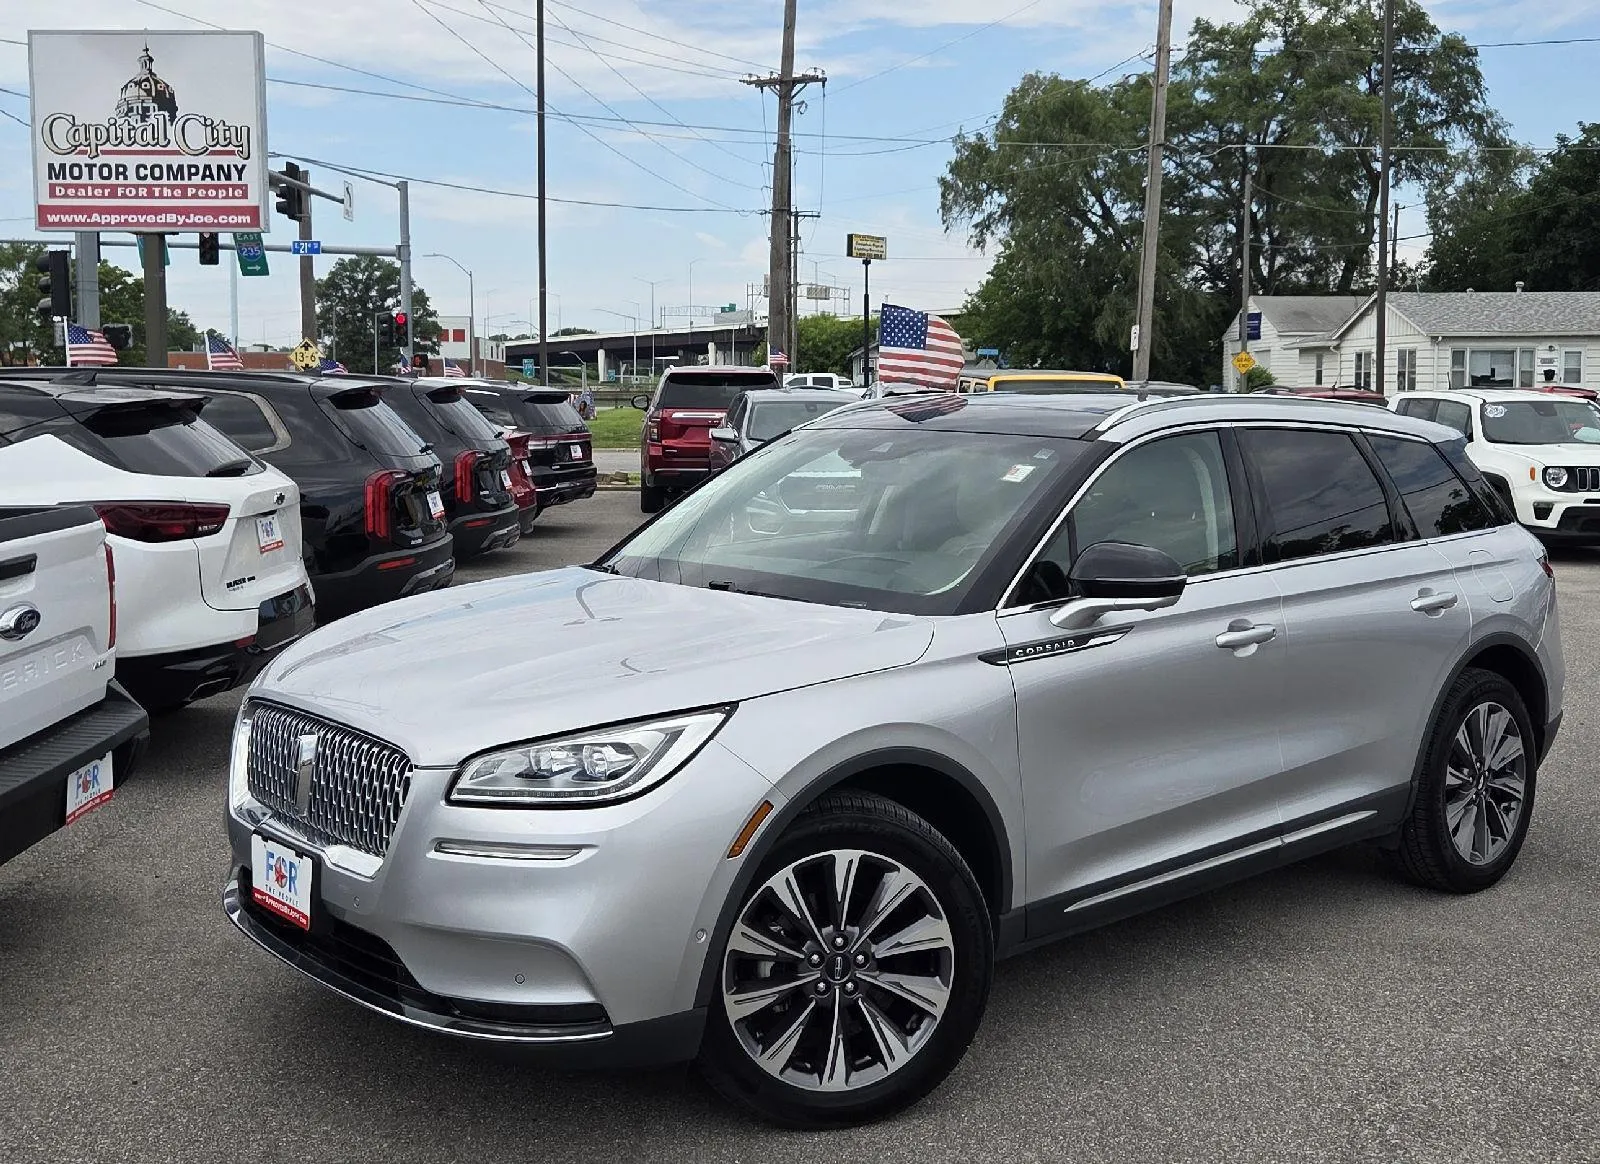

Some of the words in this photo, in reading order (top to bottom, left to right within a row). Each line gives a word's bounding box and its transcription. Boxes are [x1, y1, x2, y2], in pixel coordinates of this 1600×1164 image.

[41, 112, 171, 159] Capital
[174, 113, 250, 160] City
[47, 162, 128, 181] MOTOR
[135, 163, 247, 182] COMPANY
[55, 186, 110, 197] Dealer
[117, 186, 148, 197] FOR
[152, 186, 182, 198] The
[187, 186, 243, 199] People
[46, 212, 251, 225] www.ApprovedByJoe.com
[241, 247, 261, 256] 235
[1015, 639, 1075, 656] CORSAIR
[265, 850, 298, 896] FOR
